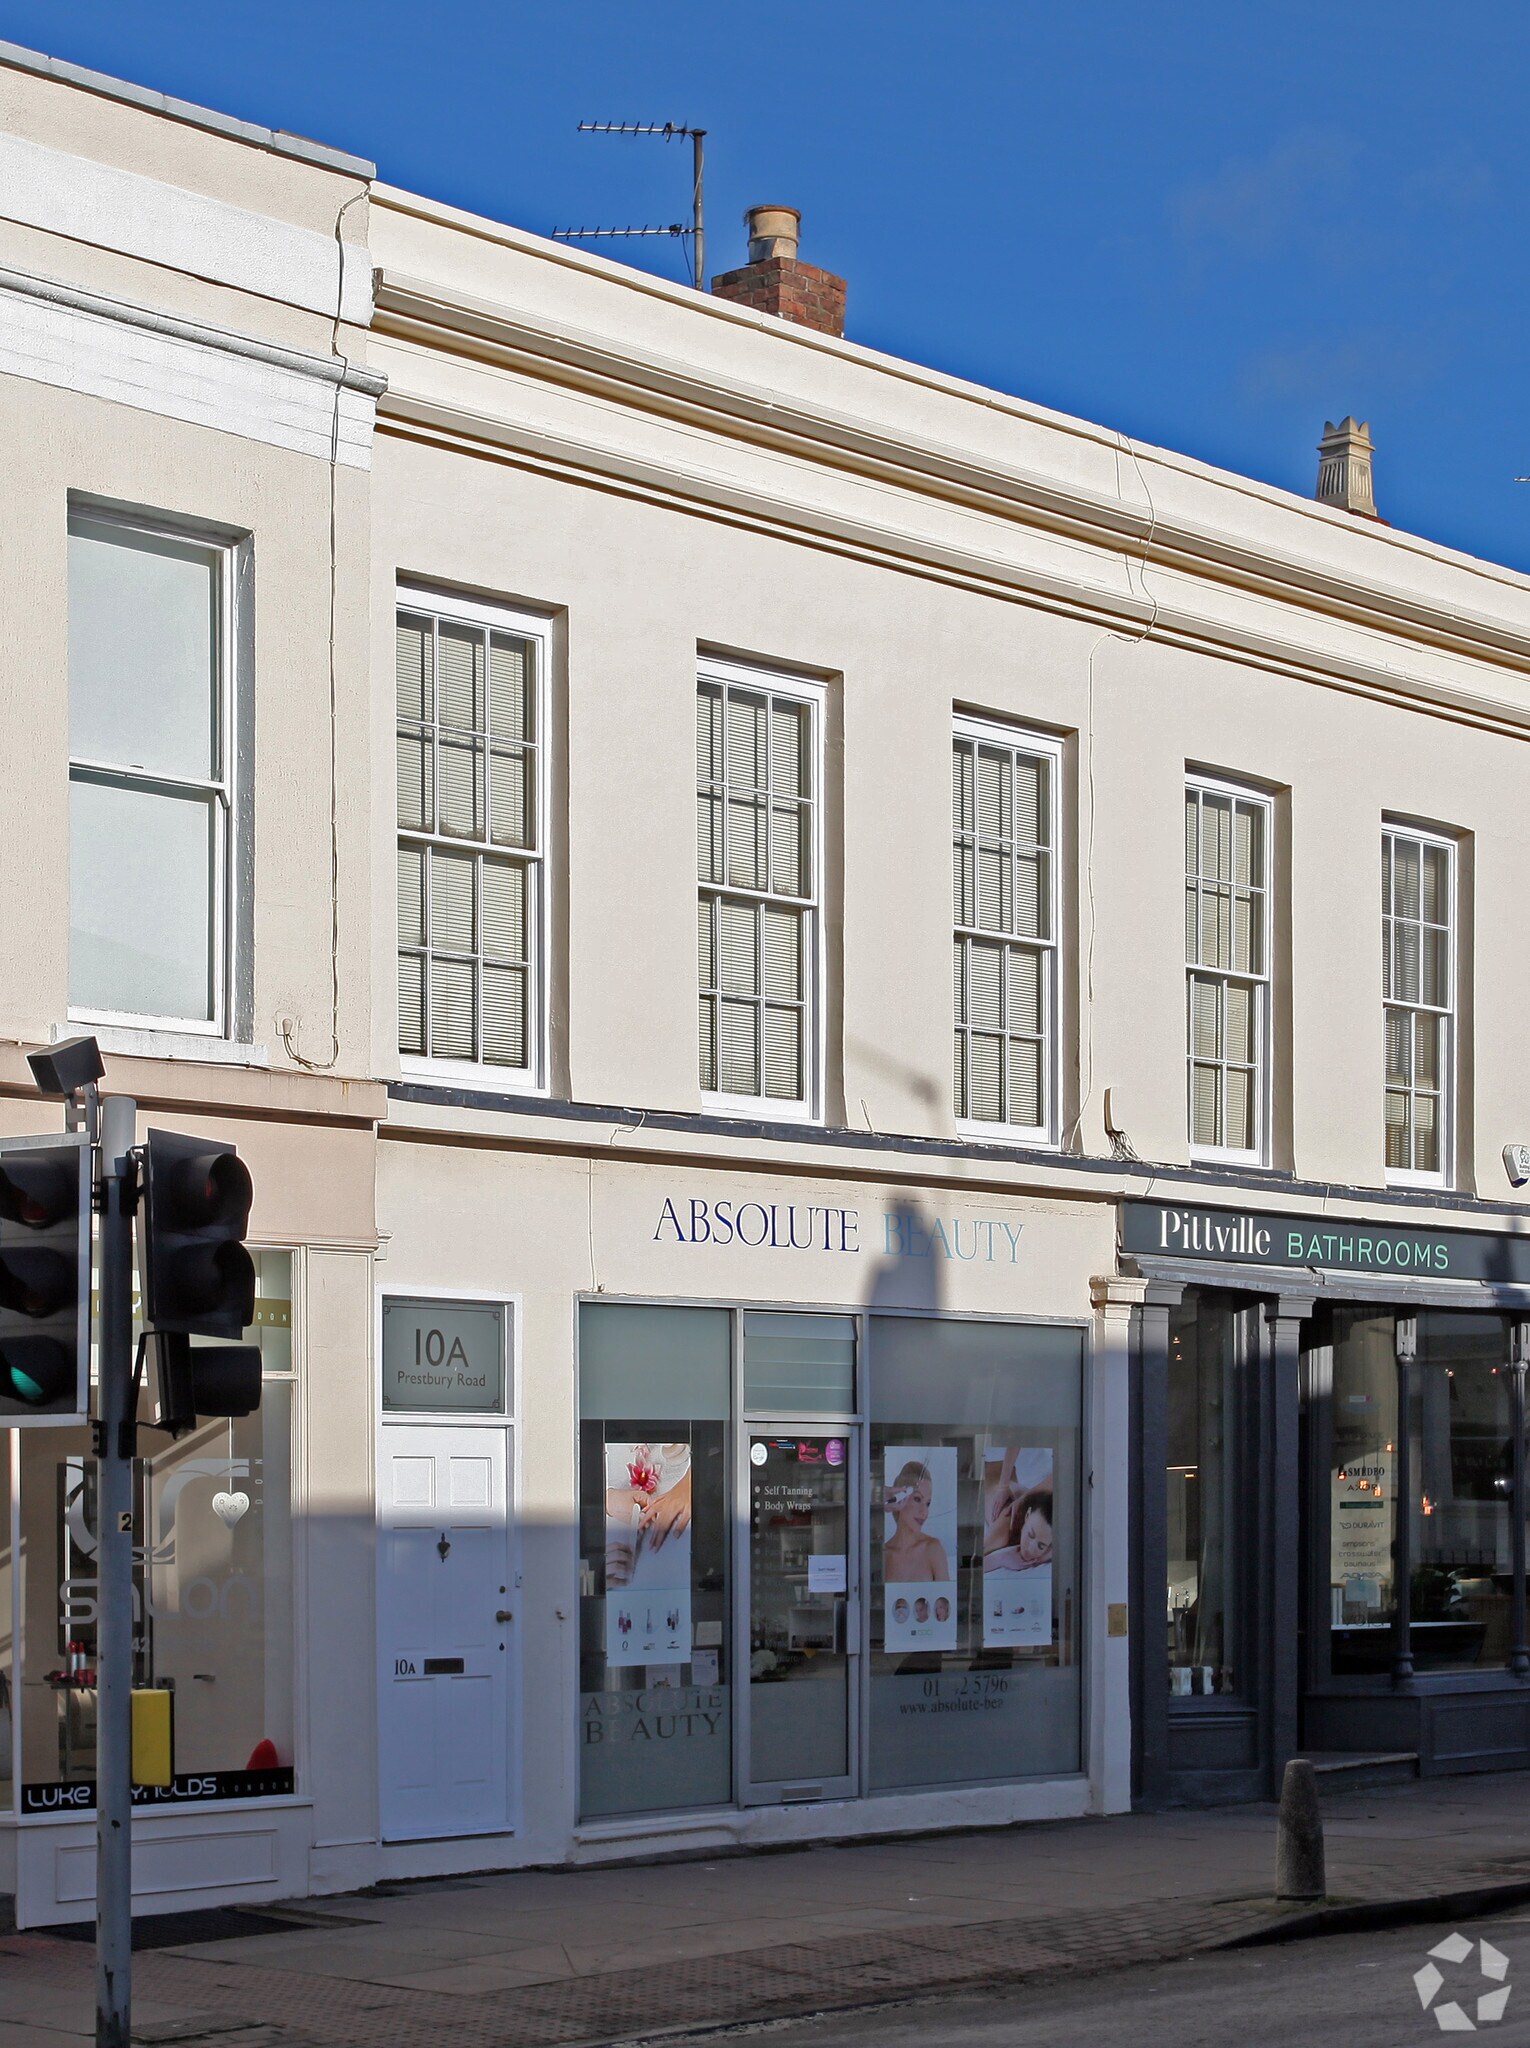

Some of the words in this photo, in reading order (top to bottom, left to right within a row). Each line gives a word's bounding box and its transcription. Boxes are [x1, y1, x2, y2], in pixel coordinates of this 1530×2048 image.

[653, 1197, 861, 1253] ABSOLUTE
[881, 1212, 1025, 1264] BEAUTY
[1159, 1209, 1271, 1256] Pittville
[1286, 1232, 1450, 1270] BATHROOMS
[415, 1328, 470, 1368] 10A
[397, 1370, 453, 1389] Prestbury
[457, 1373, 486, 1387] Road
[764, 1485, 780, 1496] Self
[781, 1485, 814, 1498] Tanning
[764, 1500, 785, 1513] Body
[786, 1500, 812, 1512] Wraps
[120, 1512, 132, 1532] 2
[1352, 1521, 1385, 1530] DURAVIT
[60, 1576, 261, 1625] SLON
[394, 1658, 416, 1675] 10A
[584, 1712, 723, 1745] BEAUTY
[27, 1785, 91, 1808] LUKE
[221, 1781, 290, 1795] LONDON
